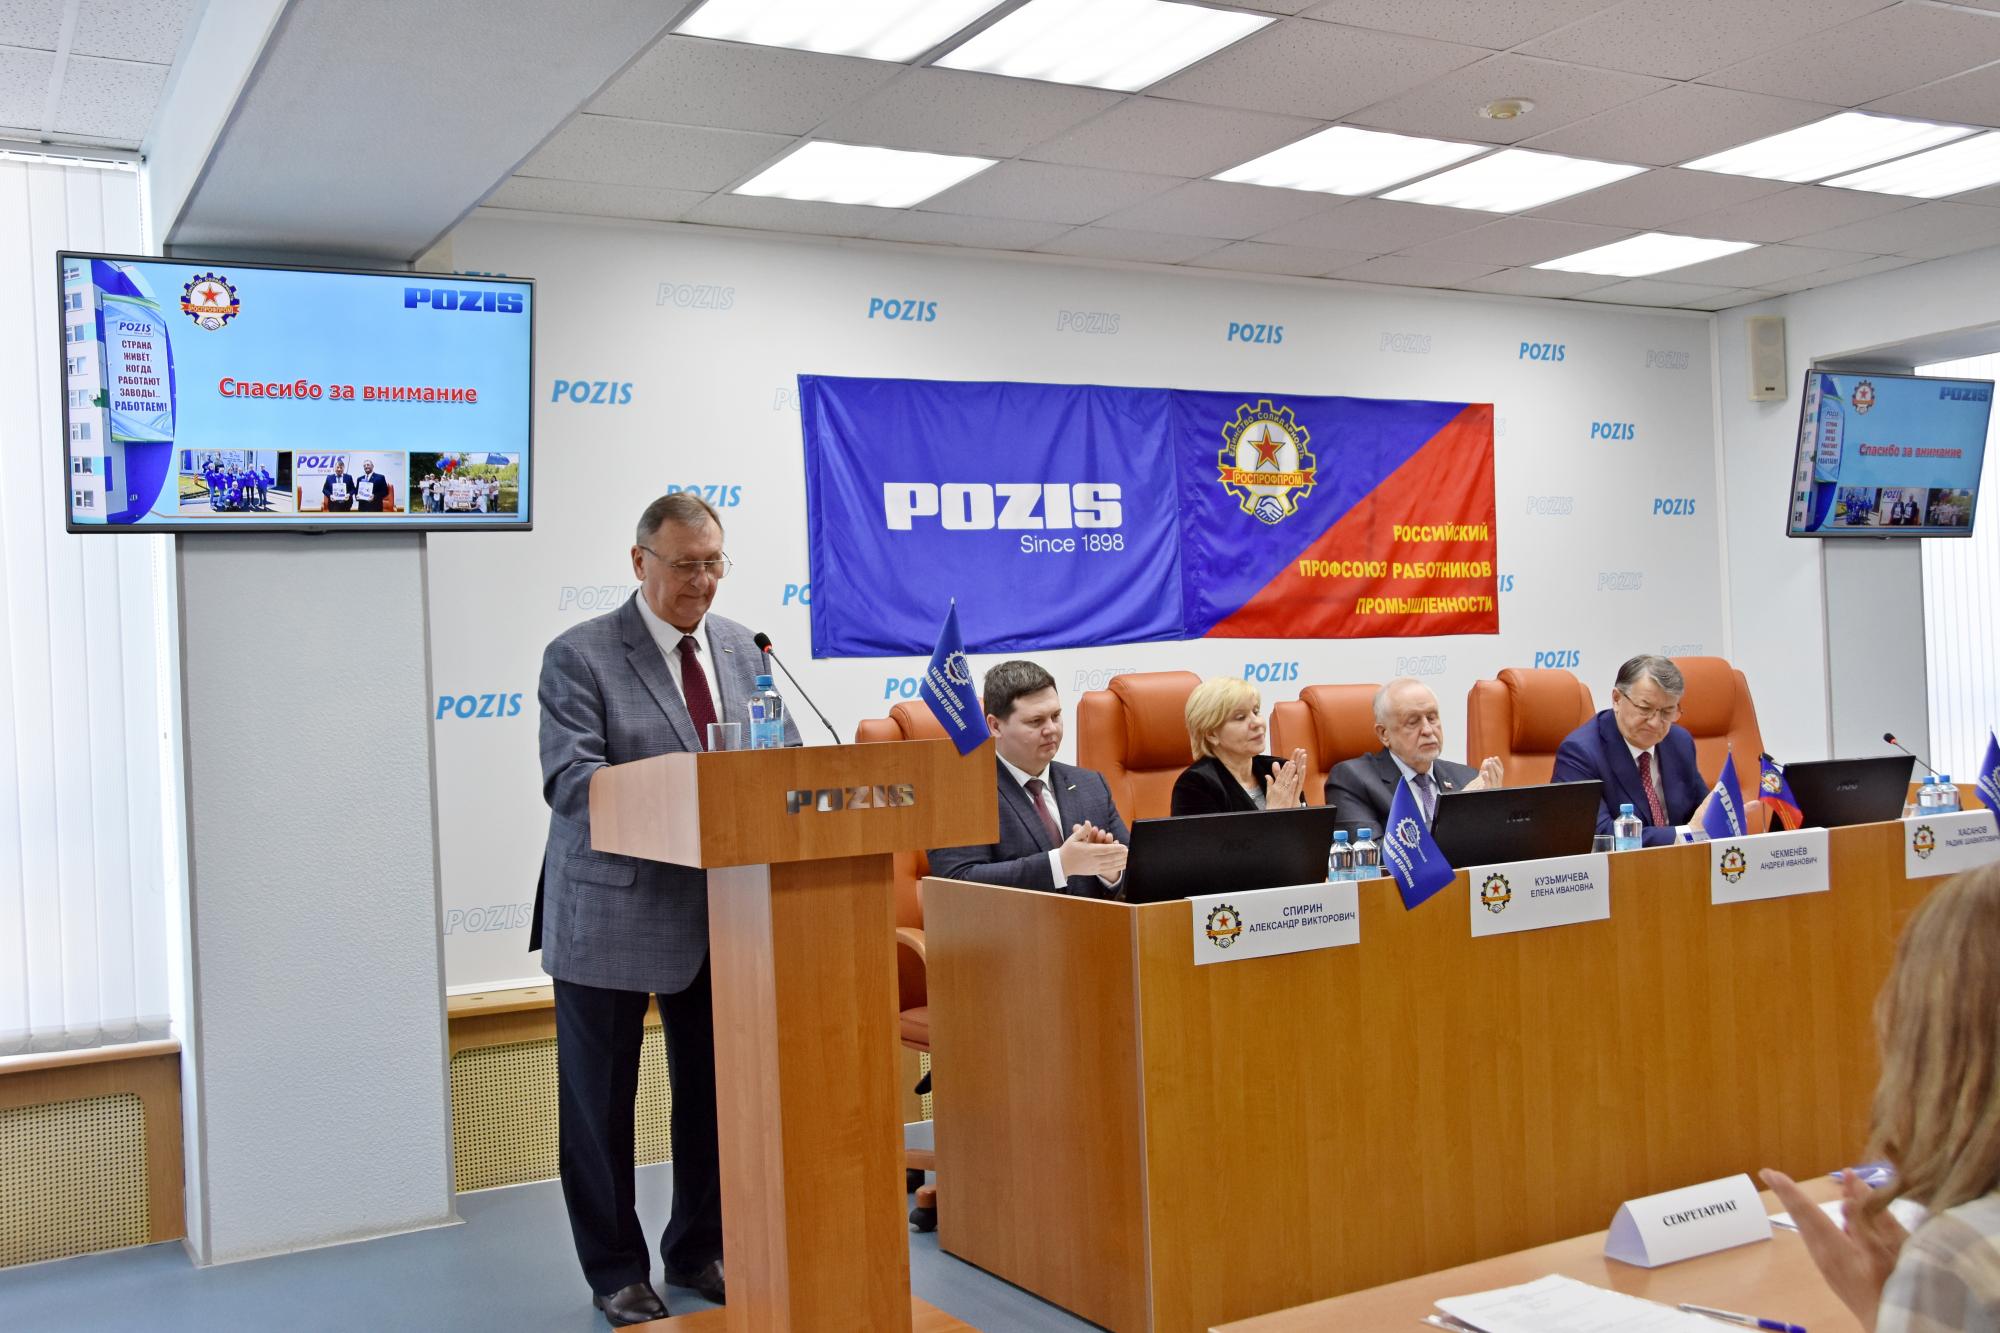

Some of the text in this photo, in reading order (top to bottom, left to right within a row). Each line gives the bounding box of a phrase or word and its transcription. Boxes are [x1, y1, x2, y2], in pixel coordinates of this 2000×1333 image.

[404, 287, 523, 313] POZIS
[868, 297, 937, 322] POZIS
[118, 322, 151, 332] POZIS
[1228, 322, 1283, 344] POZIS
[121, 340, 152, 350] СТРАНА
[1519, 342, 1566, 361] POZIS
[125, 364, 152, 374] КОГДА
[118, 376, 160, 386] РАБОТАЮТ
[218, 377, 478, 403] Спасибо за внимание
[552, 379, 634, 405] POZIS
[1939, 386, 1989, 401] POZIS
[115, 401, 168, 412] РАБОТАЕМ!
[1228, 412, 1305, 460] ЕДИНСТВО СОЛИДАРНОСТЬ
[1591, 423, 1635, 440] POZIS
[1859, 443, 1963, 459] Спасибо за внимание
[1235, 473, 1302, 485] РОСПРОФПРОМ
[883, 482, 1122, 531] POZIS
[1653, 498, 1696, 515] POZIS
[1393, 523, 1488, 542] РОССИЙСКИЙ
[1020, 533, 1124, 553] Since 1898
[1299, 559, 1492, 578] ПРОФСОЮЗ РАБОТНИКОВ
[1356, 595, 1493, 615] ПРОМЫШЛЕННОСТИ
[1535, 649, 1579, 668] POZIS
[1244, 662, 1299, 682] POZIS
[436, 693, 522, 719] POZIS
[940, 696, 968, 731] ОТДЕЛЕНИЕ
[786, 784, 914, 814] POZIS
[1760, 857, 1818, 870] АНДРЕЙ ИВАНОВИЧ
[1535, 871, 1589, 886] КУЗЬМИЧЕВА
[1530, 882, 1594, 898] ЕЛЕНА ИВАНОВНА
[443, 903, 532, 935] POZIS
[1282, 903, 1323, 917] СПИРИН
[1249, 918, 1300, 933] АЛЕКСАНДР
[1301, 911, 1356, 927] ВИКТОРОВИЧ
[1663, 1199, 1737, 1227] СЕКРЕТАРИАТ
